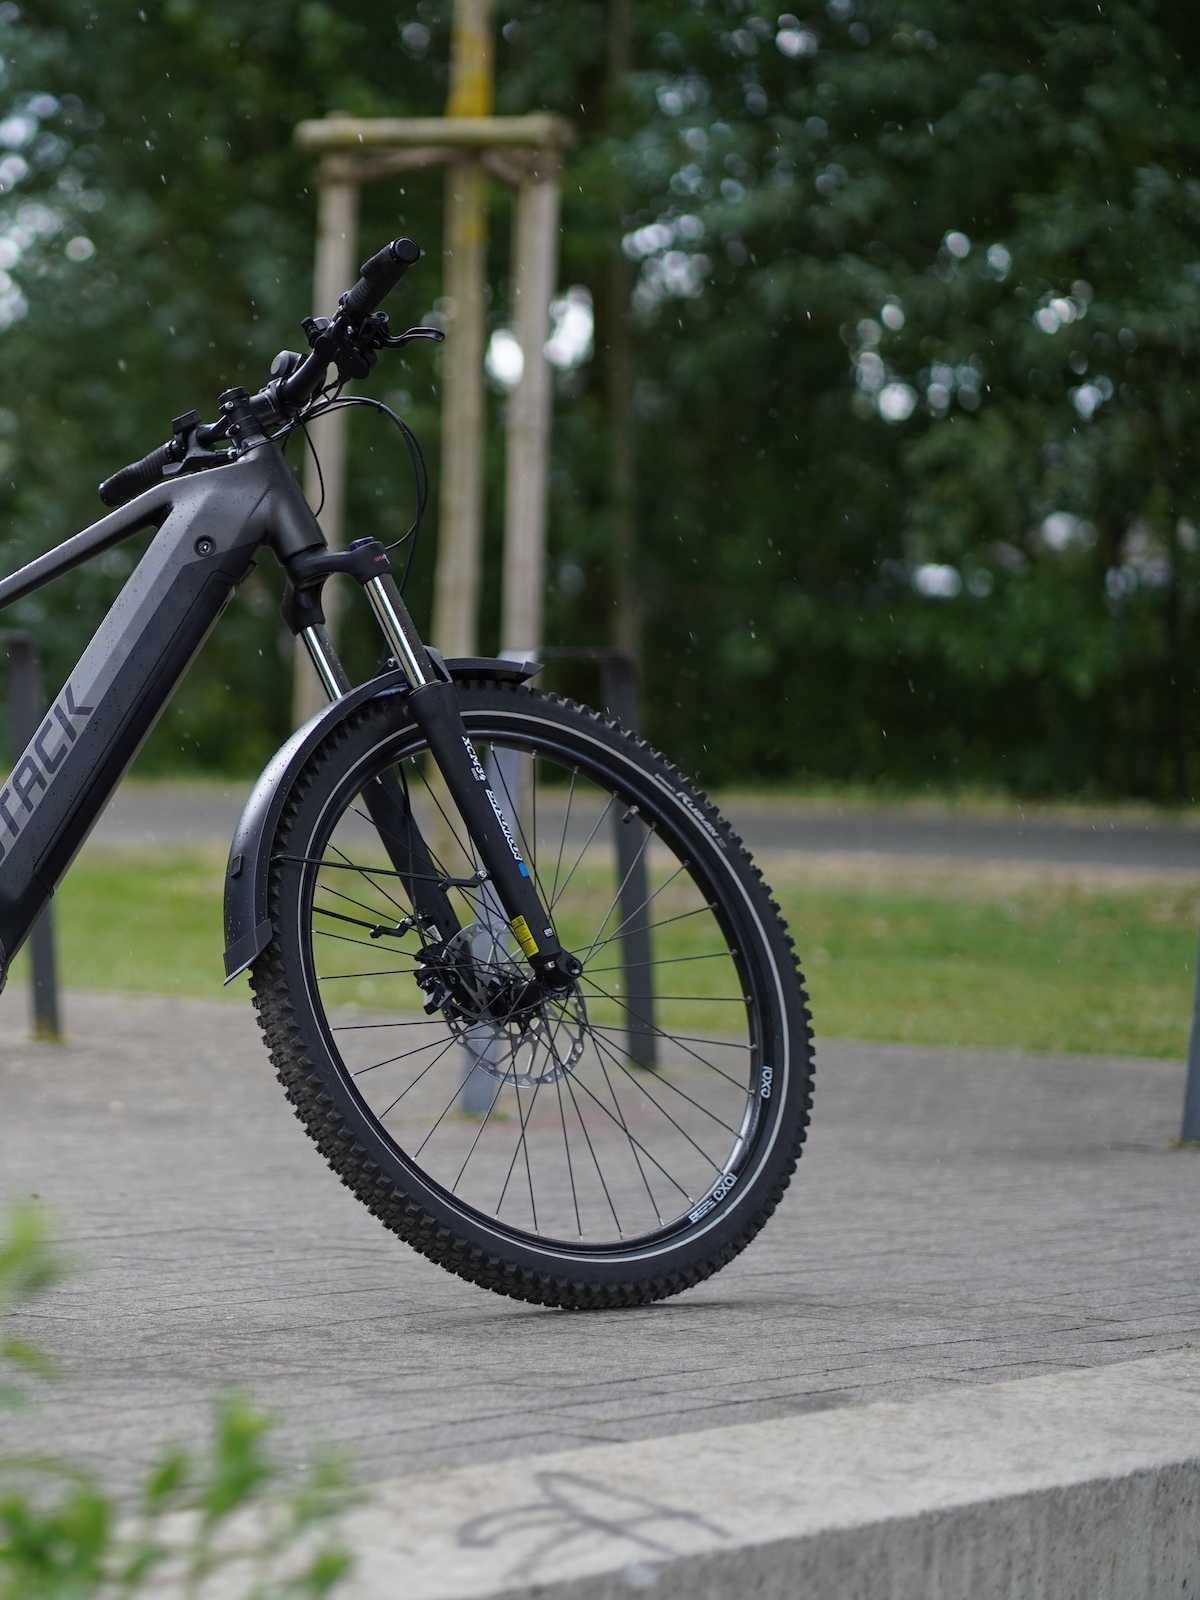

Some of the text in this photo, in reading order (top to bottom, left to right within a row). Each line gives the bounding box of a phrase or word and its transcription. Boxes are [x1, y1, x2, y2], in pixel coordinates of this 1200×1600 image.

[461, 736, 487, 781] XCM34
[676, 791, 719, 837] RUBAN
[760, 1065, 773, 1099] exal
[712, 1172, 739, 1201] exal
